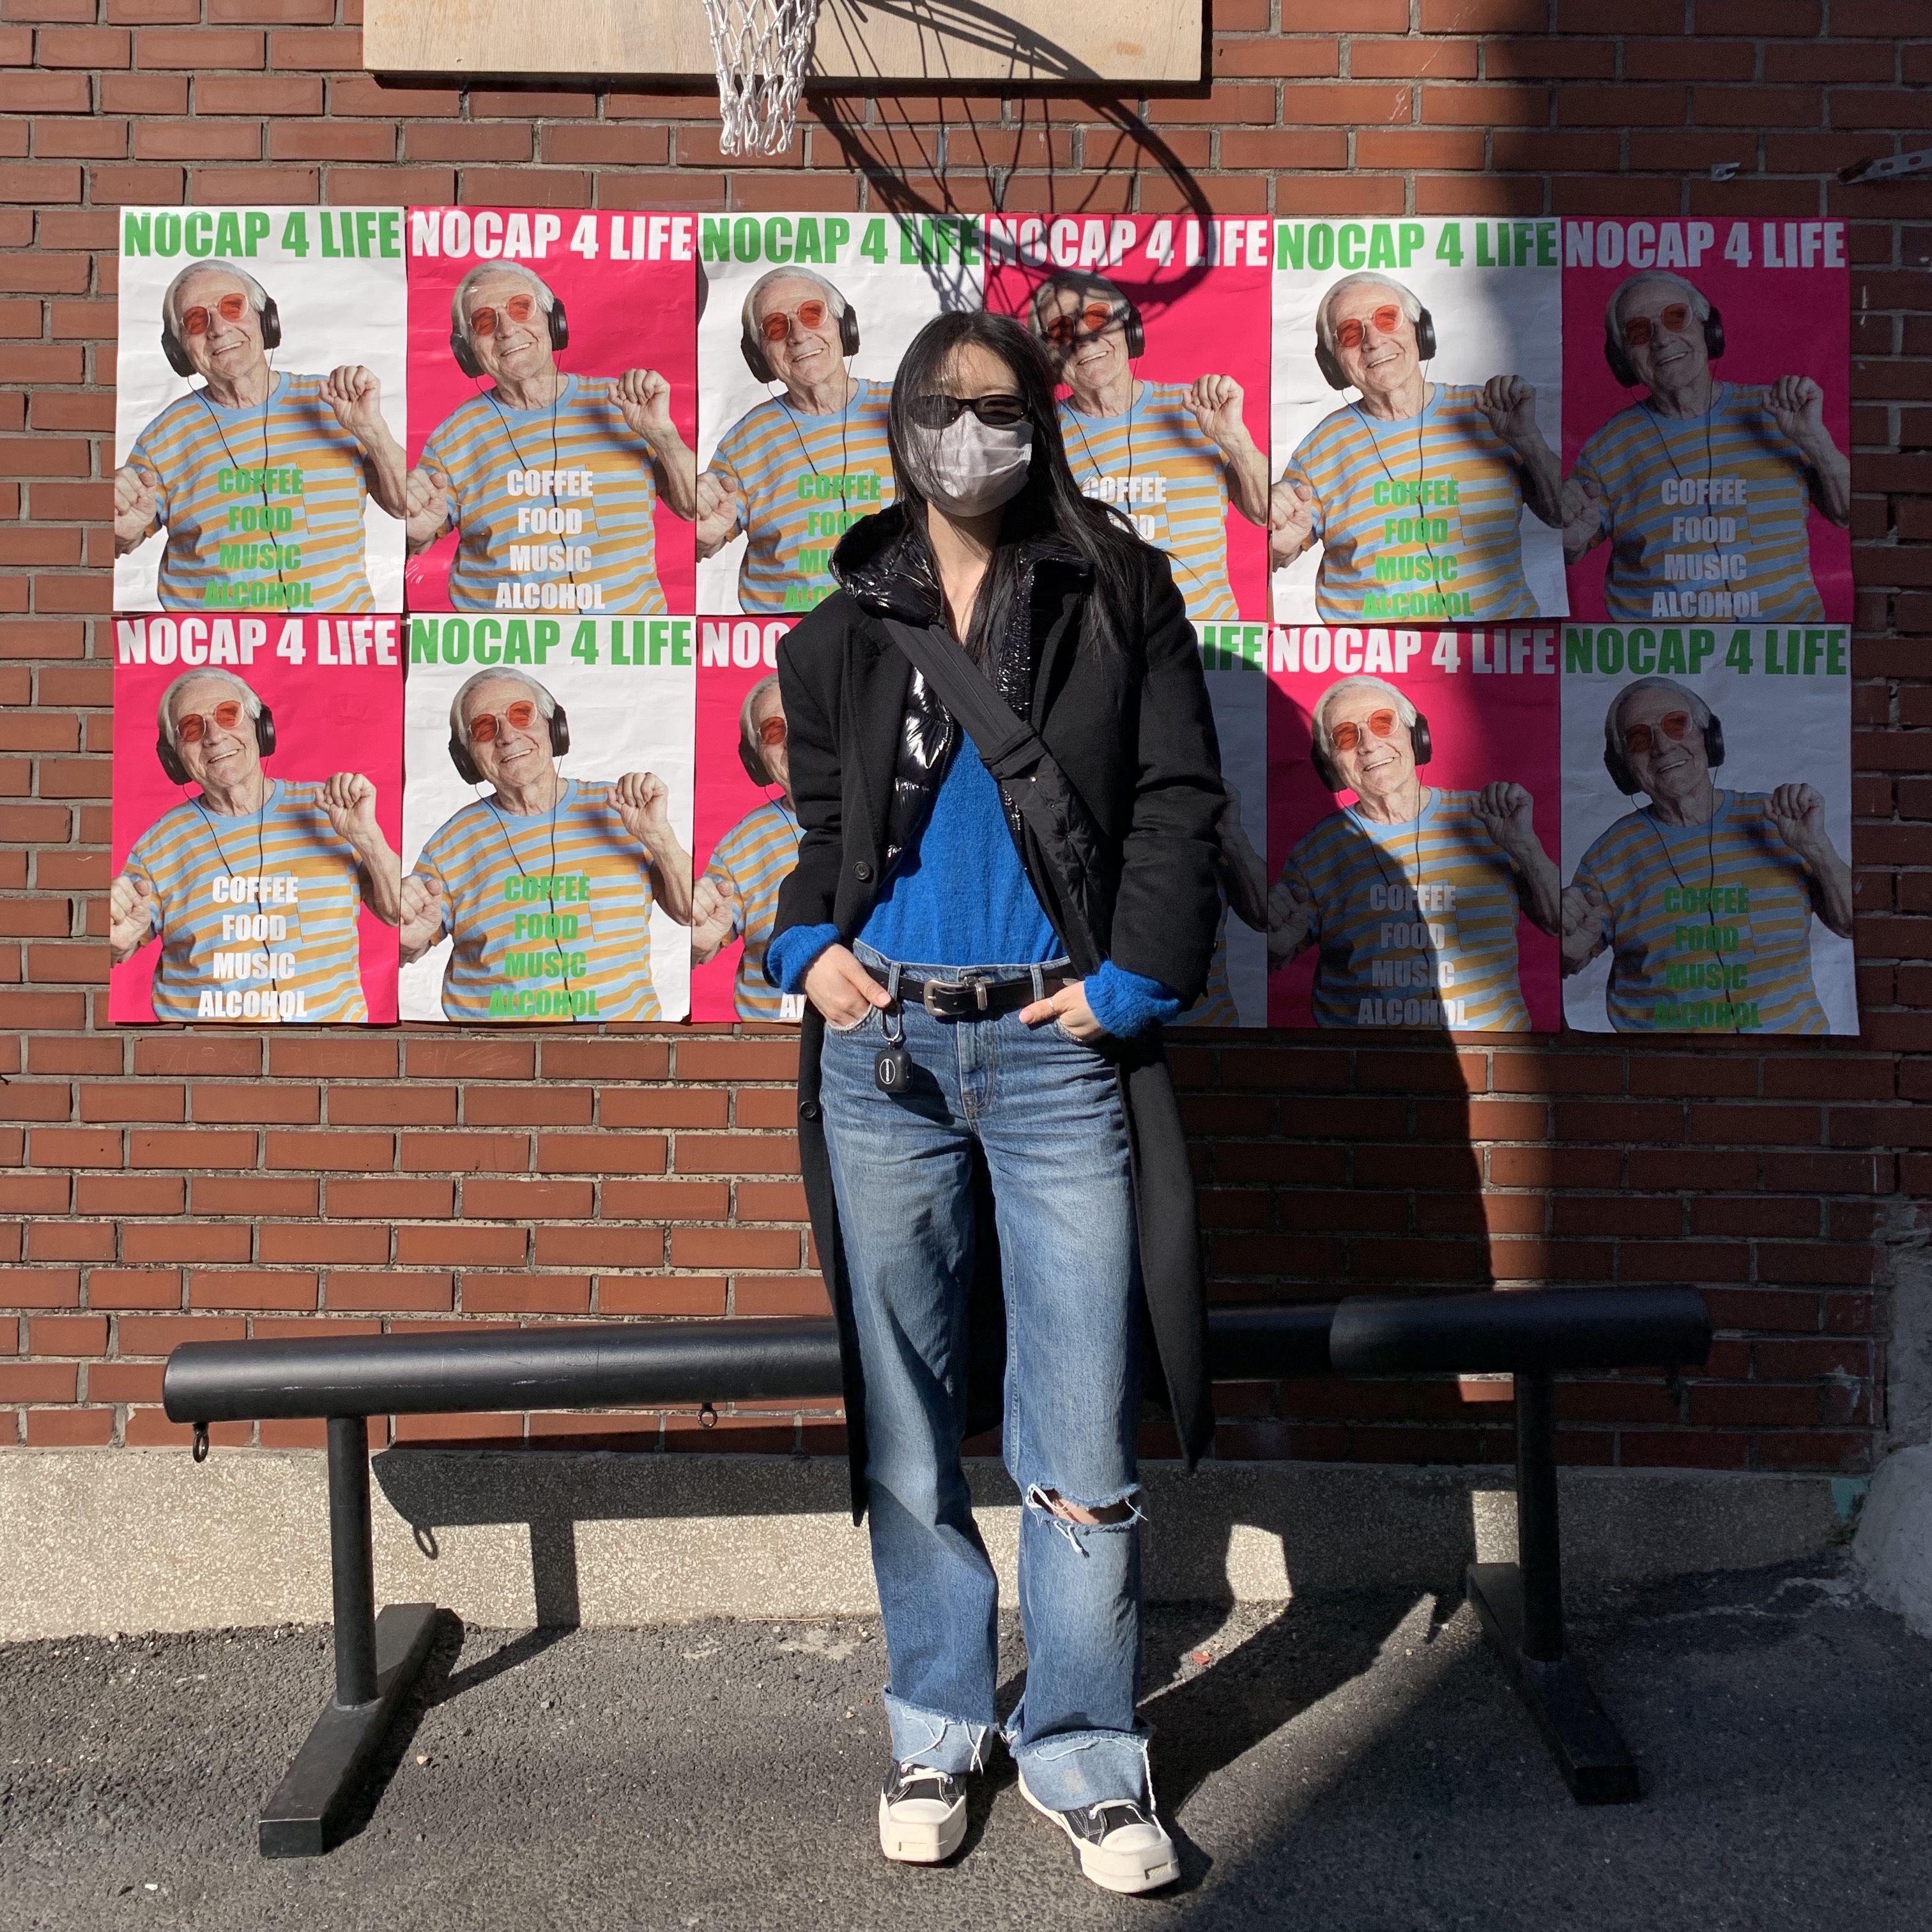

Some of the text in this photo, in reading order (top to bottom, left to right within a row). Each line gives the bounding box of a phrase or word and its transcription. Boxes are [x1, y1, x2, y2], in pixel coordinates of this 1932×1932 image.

[124, 211, 401, 258] NOCAP 4 LIFE
[412, 211, 692, 261] NOCAP 4 LIFE
[703, 217, 980, 265] NOCAP 4 LIFE
[989, 218, 1268, 267] NOCAP 4 LIFE
[1277, 222, 1559, 271] NOCAP 4 LIFE
[1565, 221, 1846, 268] NOCAP 4 LIFE
[217, 468, 303, 494] COFFEE
[507, 469, 594, 496] COFFEE
[798, 473, 881, 500] COFFEE
[1373, 480, 1460, 507] COFFEE
[1661, 479, 1747, 505] COFFEE
[229, 507, 292, 533] FOOD
[518, 507, 582, 534] FOOD
[808, 511, 866, 537] FOO
[1384, 518, 1448, 544] FOOD
[1673, 517, 1736, 543] FOOD
[218, 544, 302, 571] MUSIC
[510, 545, 592, 572] MUSIC
[1375, 555, 1457, 582] MUSIC
[1664, 554, 1747, 581] MUSIC
[203, 582, 314, 608] ALCOHOL
[495, 582, 605, 610] ALCOHOL
[1362, 592, 1475, 618] ALCOHOL
[1652, 592, 1763, 618] ALCOHOL
[117, 618, 399, 666] NOCAP 4 LIFE
[410, 618, 692, 666] NOCAP 4 LIFE
[702, 621, 790, 669] NOC
[1204, 625, 1262, 671] IFE
[1272, 627, 1556, 674] NOCAP 4 LIFE
[1565, 627, 1847, 675] NOCAP 4 LIFE
[212, 876, 299, 903] COFFEE
[504, 875, 590, 902] COFFEE
[1369, 884, 1457, 912] COFFEE
[1664, 887, 1749, 914] COFFEE
[222, 915, 287, 942] FOOD
[514, 914, 578, 940] FOOD
[1381, 923, 1445, 949] FOOD
[1675, 925, 1739, 951] FOOD
[213, 952, 296, 979] MUSIC
[504, 951, 587, 979] MUSIC
[1372, 960, 1455, 988] MUSIC
[1666, 963, 1748, 990] MUSIC
[197, 990, 308, 1018] ALCOHOL
[489, 990, 600, 1016] ALCOHOL
[1358, 999, 1469, 1026] ALCOHOL
[1654, 1002, 1764, 1029] ALCOHOL
